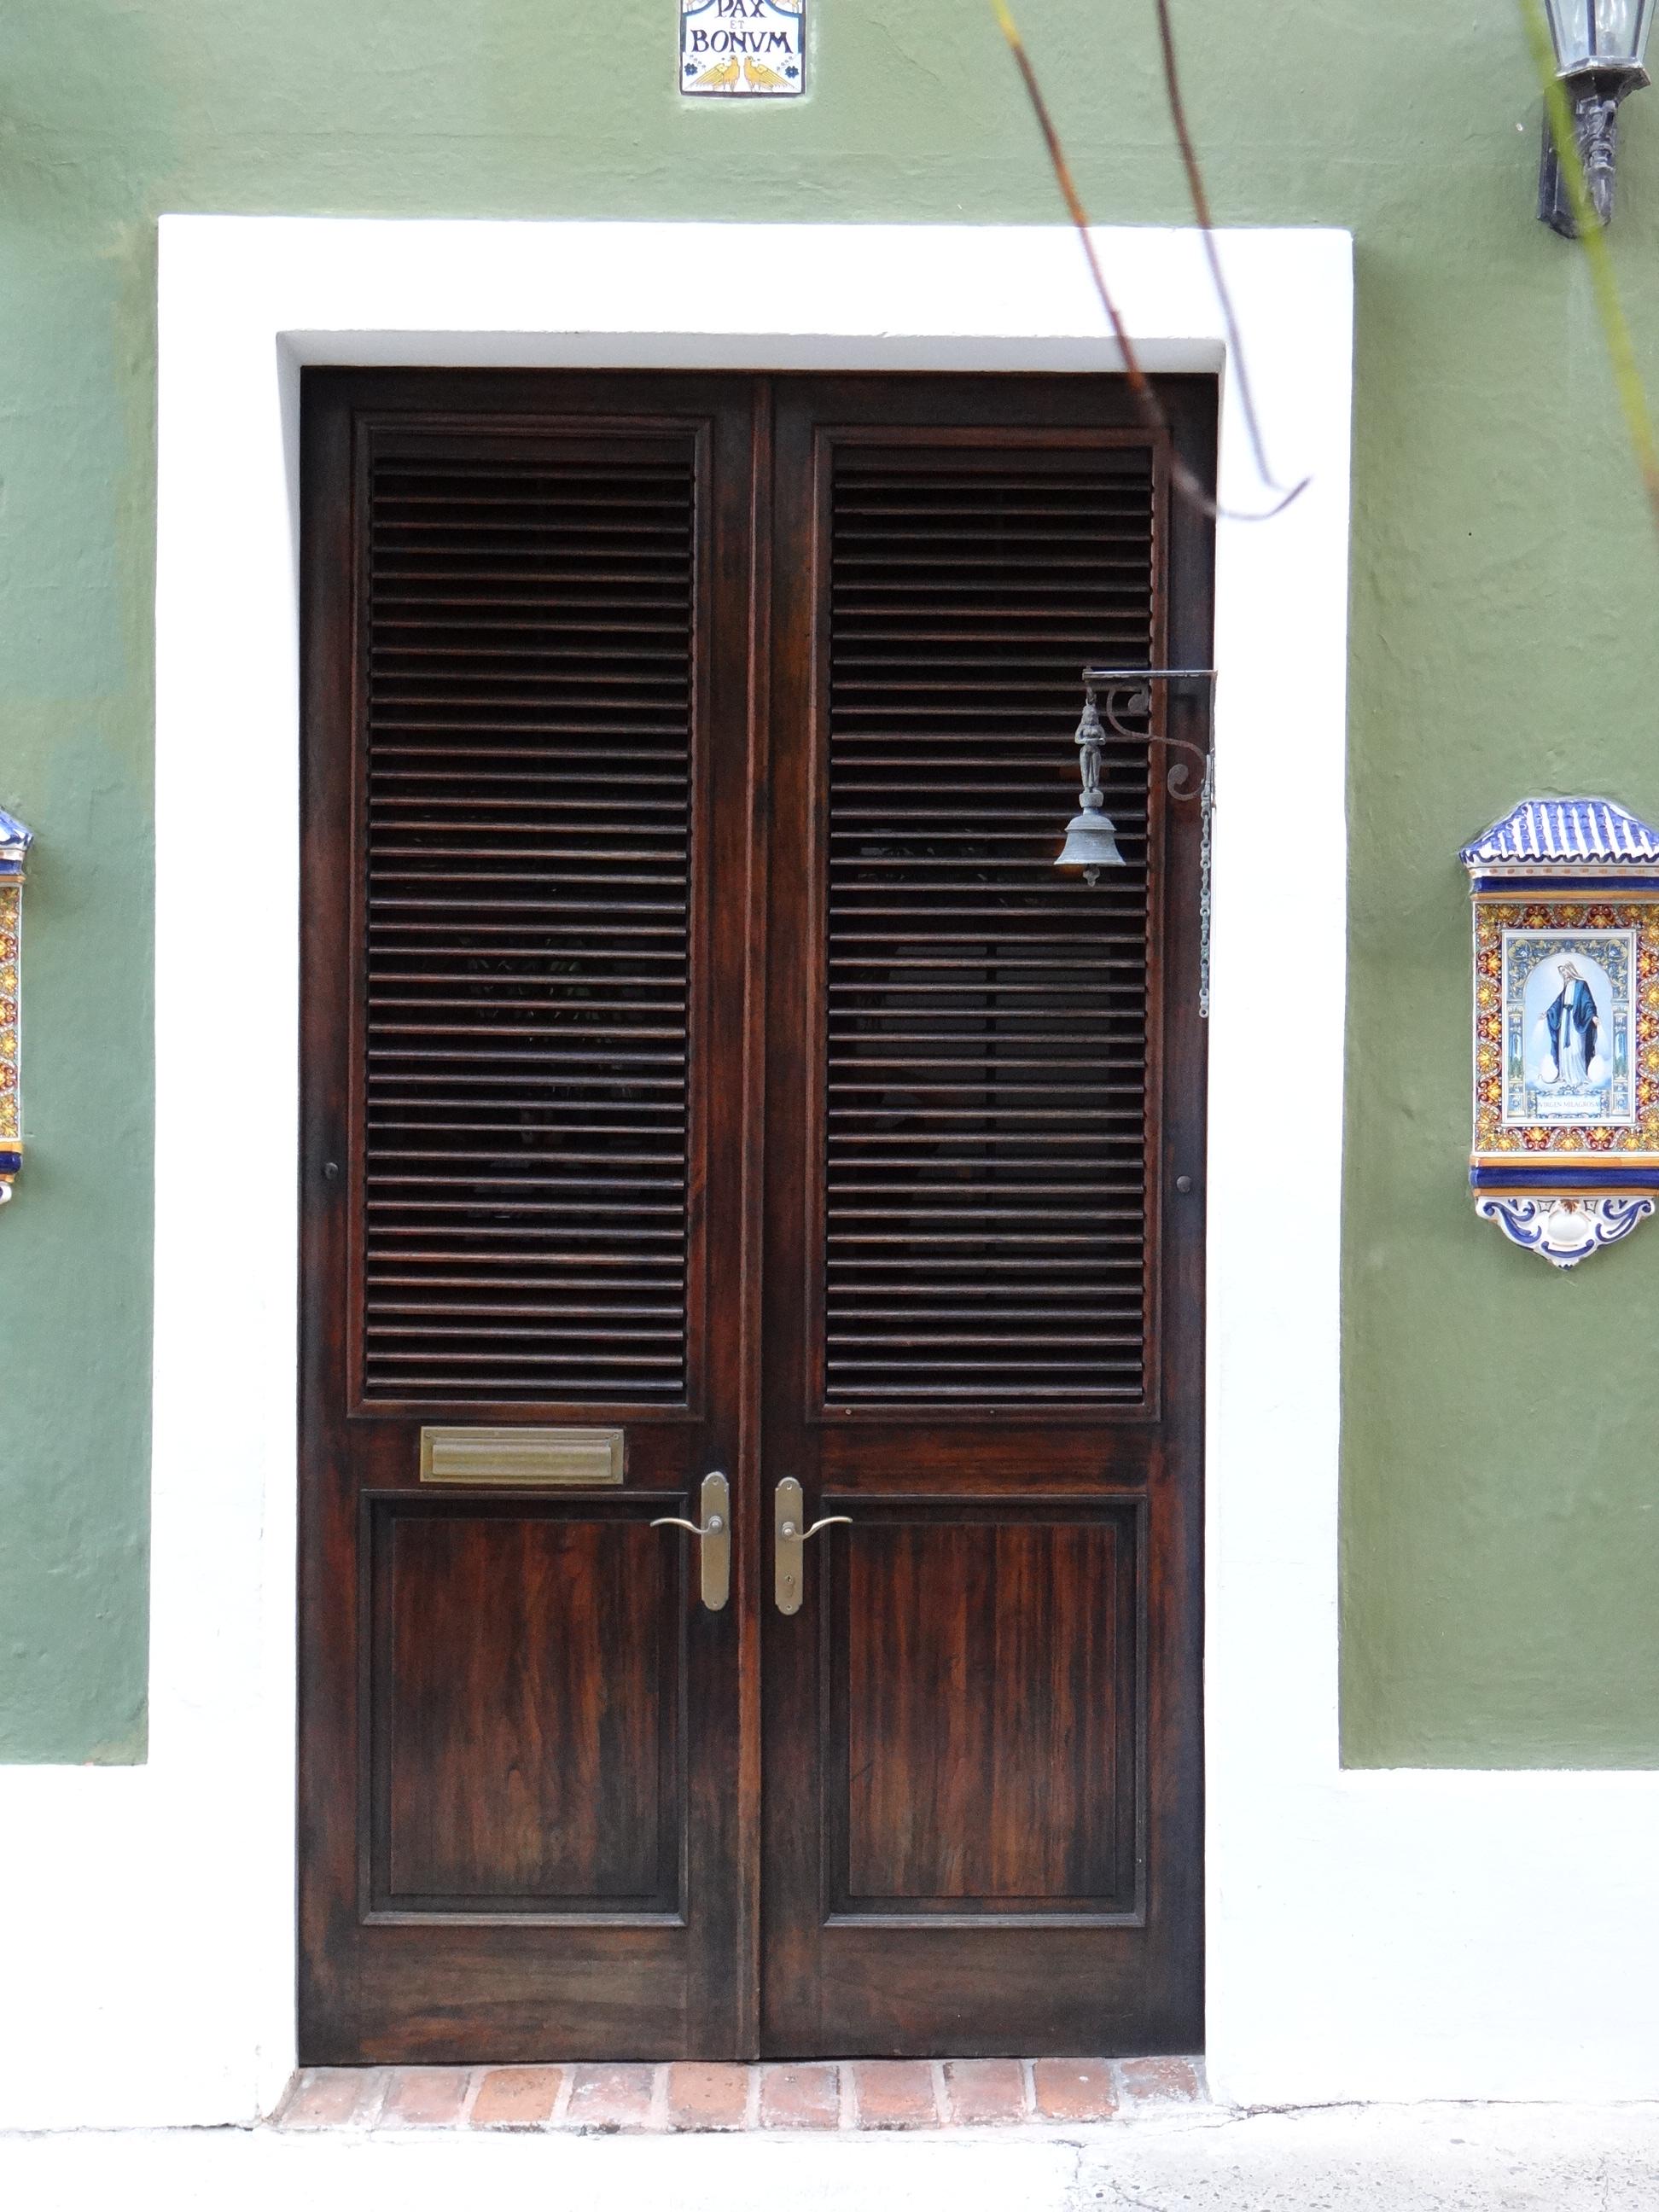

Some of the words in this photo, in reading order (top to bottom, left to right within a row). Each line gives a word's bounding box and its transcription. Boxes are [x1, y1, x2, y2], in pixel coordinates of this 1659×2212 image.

[714, 0, 767, 18] PAX
[730, 20, 745, 29] ET
[690, 29, 793, 54] BONVM
